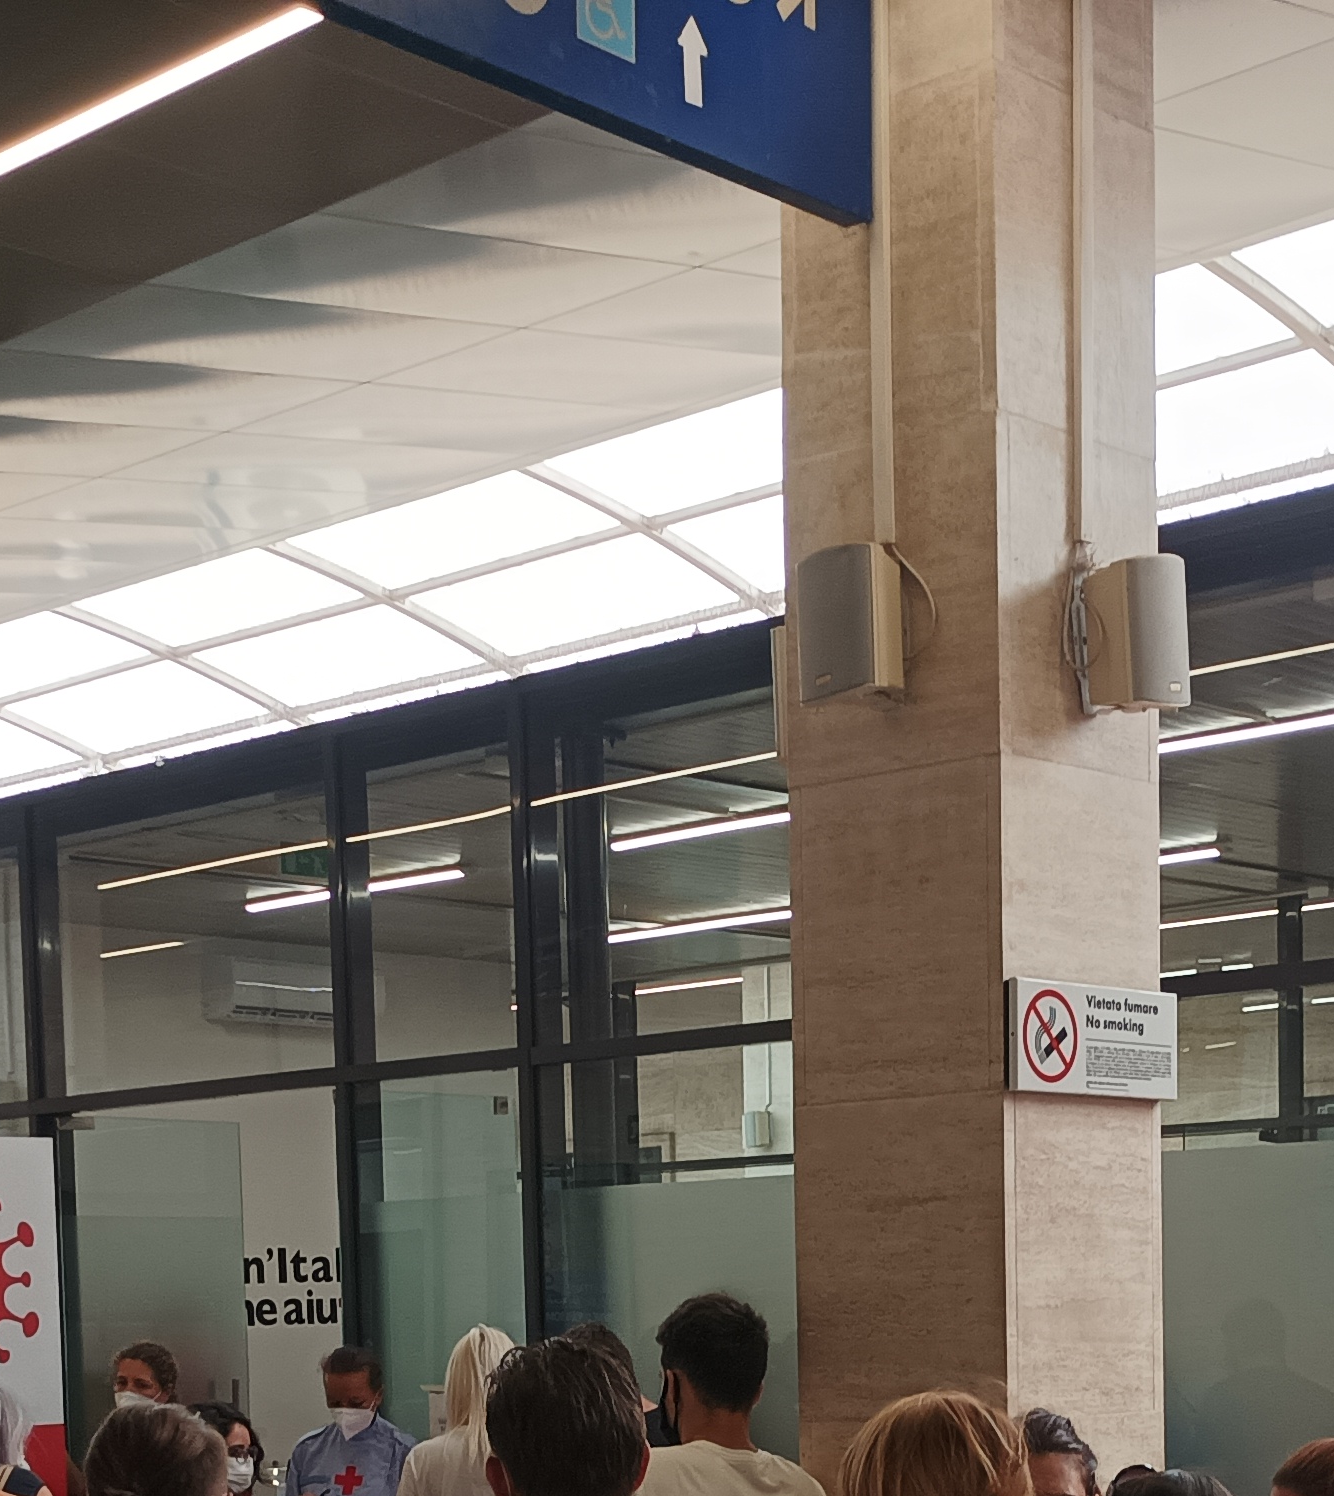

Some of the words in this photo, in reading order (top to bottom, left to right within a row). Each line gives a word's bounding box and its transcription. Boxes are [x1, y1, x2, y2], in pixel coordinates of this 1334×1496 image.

[1085, 994, 1122, 1012] Vietato
[1124, 997, 1159, 1016] fumare
[1085, 1014, 1101, 1030] No
[1103, 1017, 1145, 1037] smoking
[283, 1288, 342, 1326] aiu
